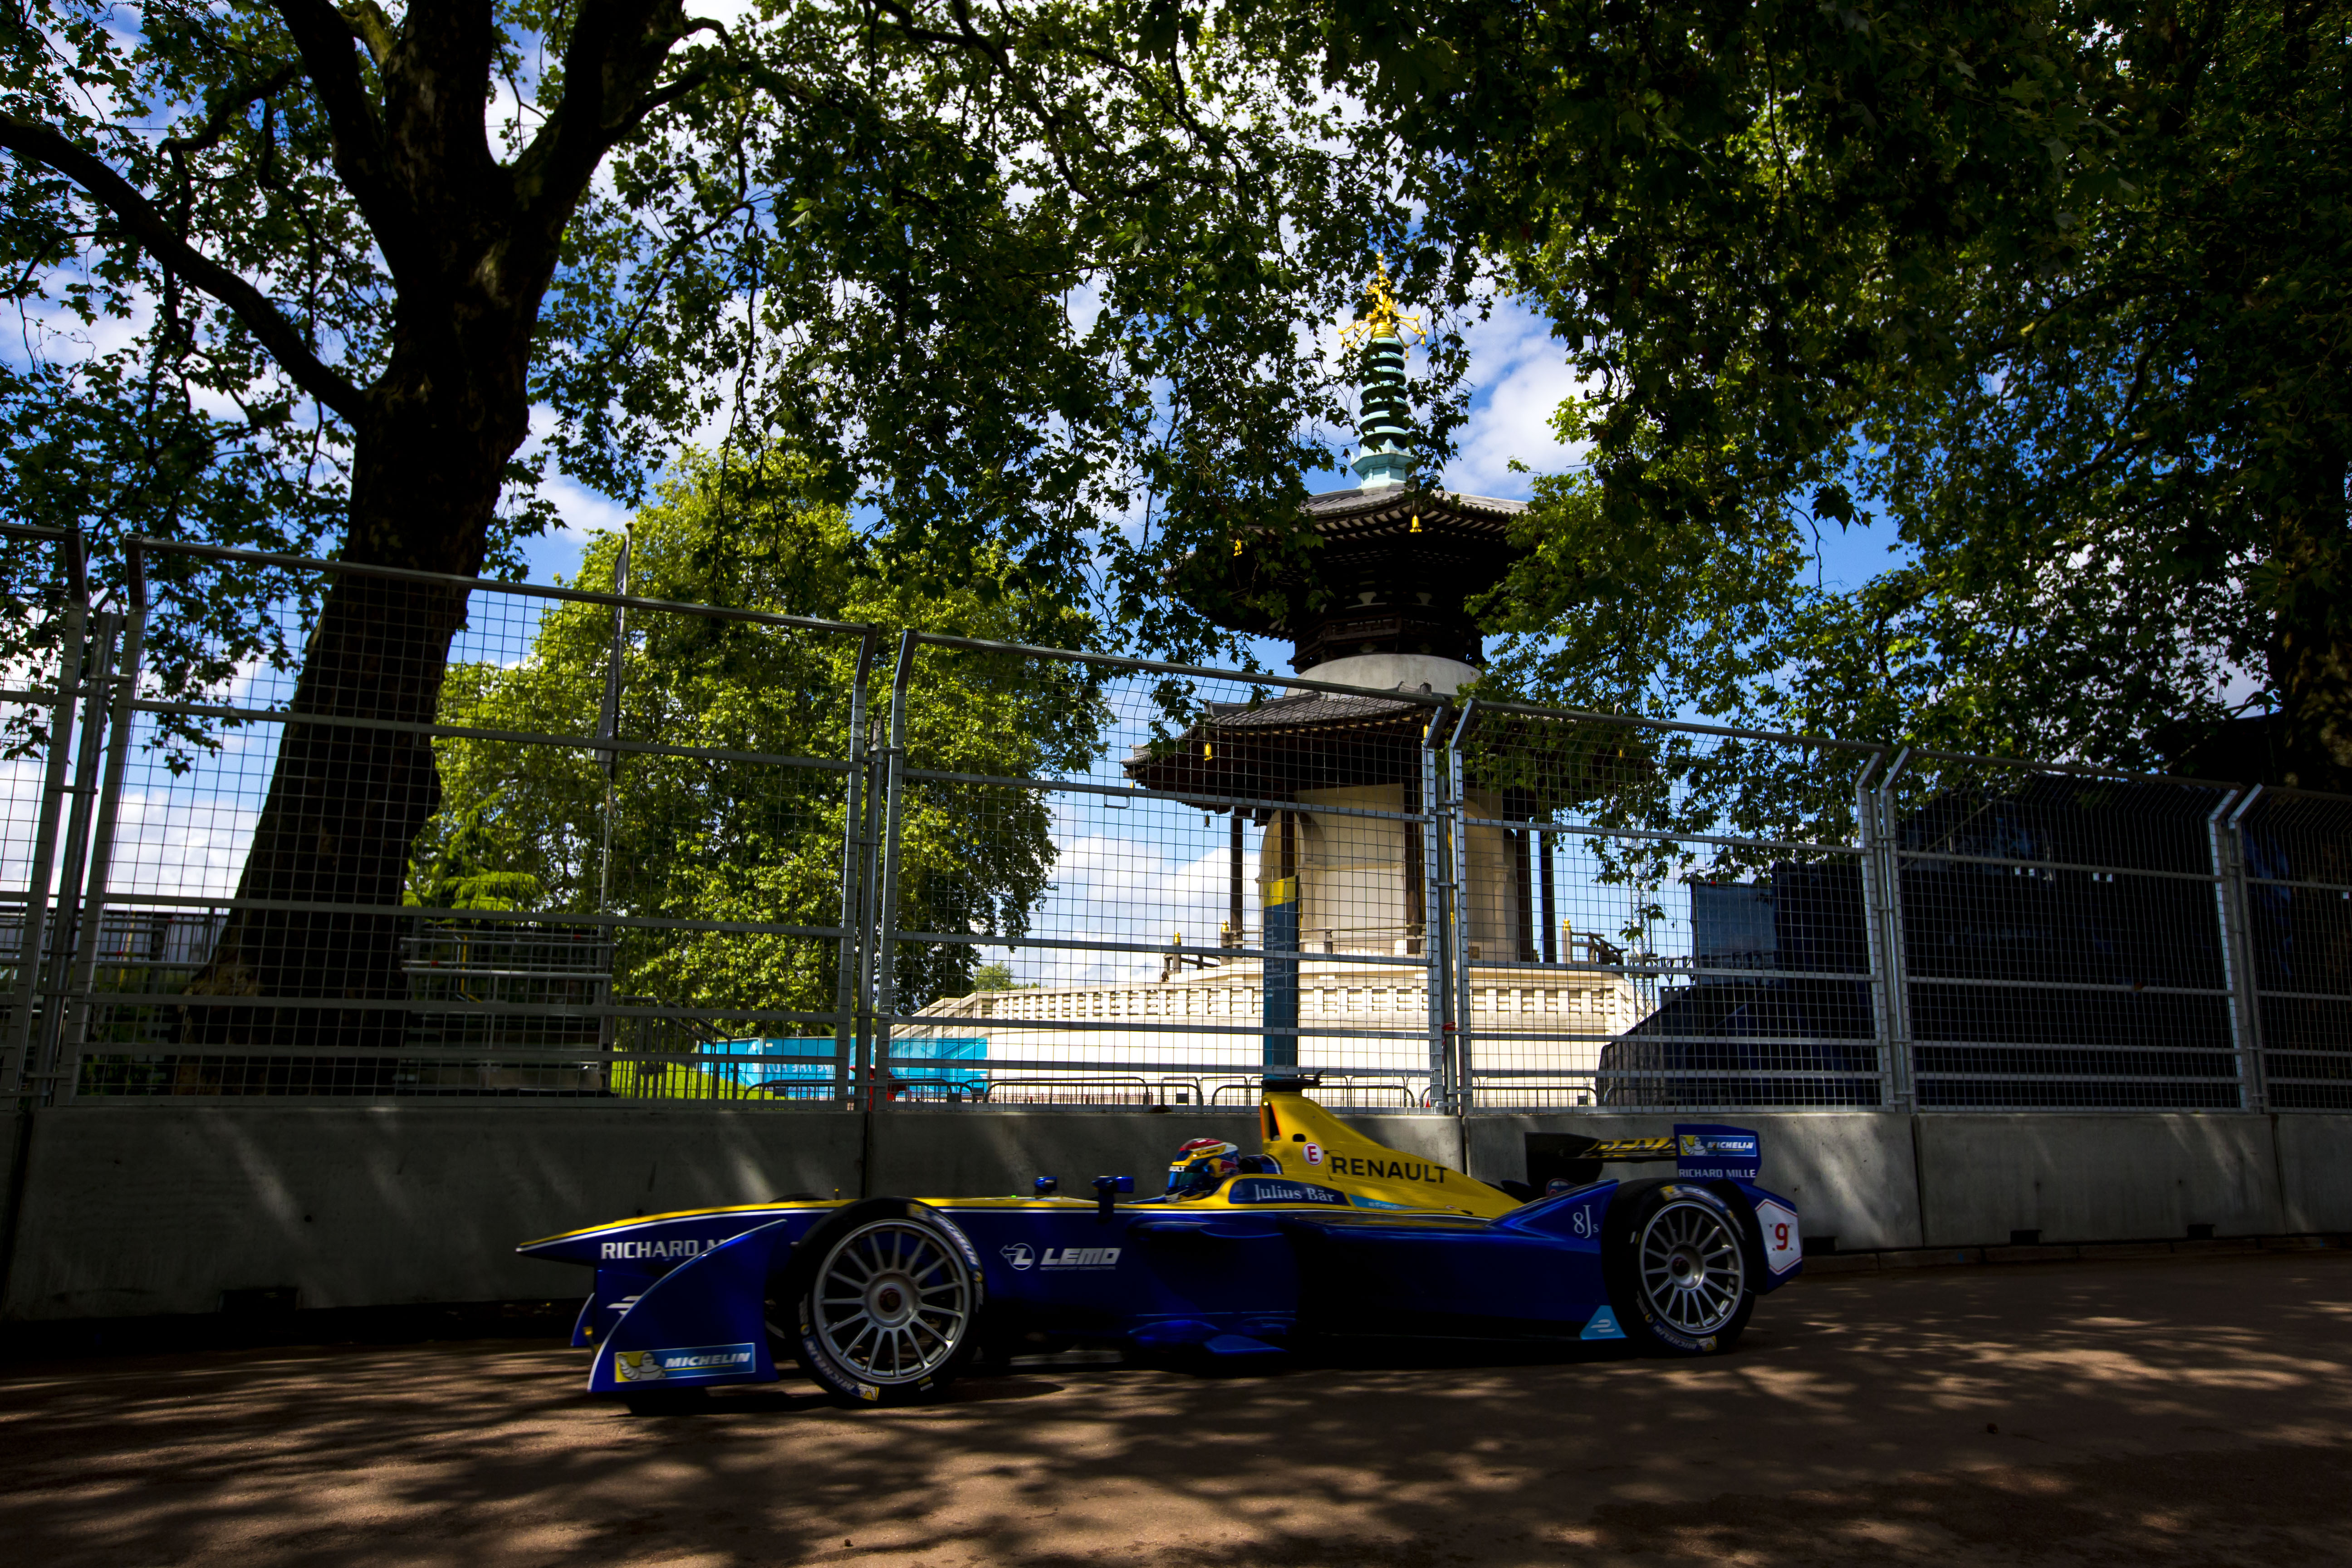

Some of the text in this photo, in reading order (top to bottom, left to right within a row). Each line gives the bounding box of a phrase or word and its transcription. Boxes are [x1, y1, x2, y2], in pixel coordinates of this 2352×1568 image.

[1308, 1146, 1318, 1161] E
[1331, 1156, 1448, 1183] RENAULT
[1679, 1169, 1756, 1178] RICHARD MILLE
[1254, 1184, 1335, 1202] Julius Bär
[1775, 1223, 1788, 1250] 9
[600, 1240, 700, 1260] RICHARD
[1039, 1248, 1122, 1265] LEMO
[664, 1352, 751, 1367] MICHELIN
